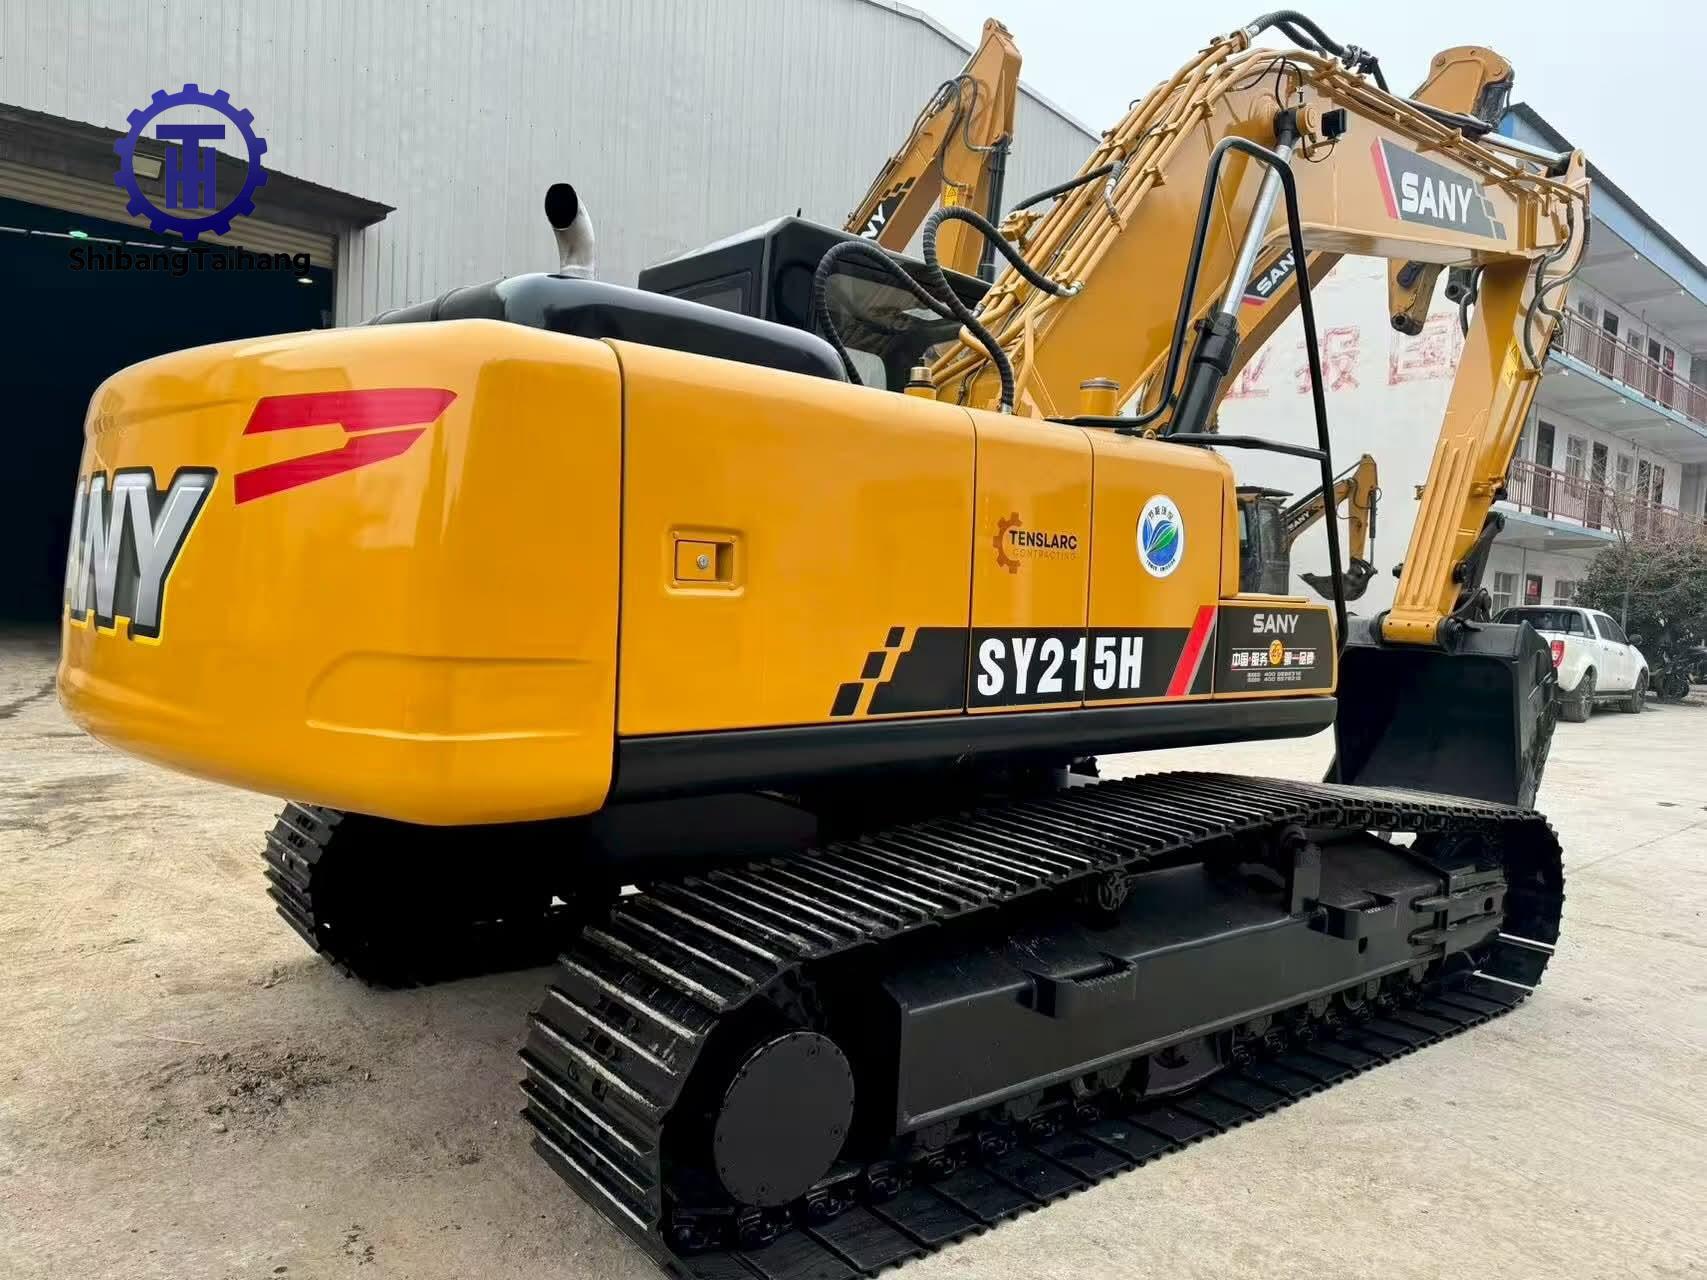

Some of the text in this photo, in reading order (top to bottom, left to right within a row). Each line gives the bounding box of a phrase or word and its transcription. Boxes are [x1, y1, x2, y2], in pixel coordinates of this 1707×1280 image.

[1401, 171, 1473, 225] SANY
[859, 202, 886, 239] NY
[1256, 250, 1296, 295] SAN
[1009, 530, 1077, 550] TENSLARC
[1013, 548, 1077, 560] CONTRACTING
[1252, 613, 1299, 633] SANY
[977, 636, 1145, 697] SY215H
